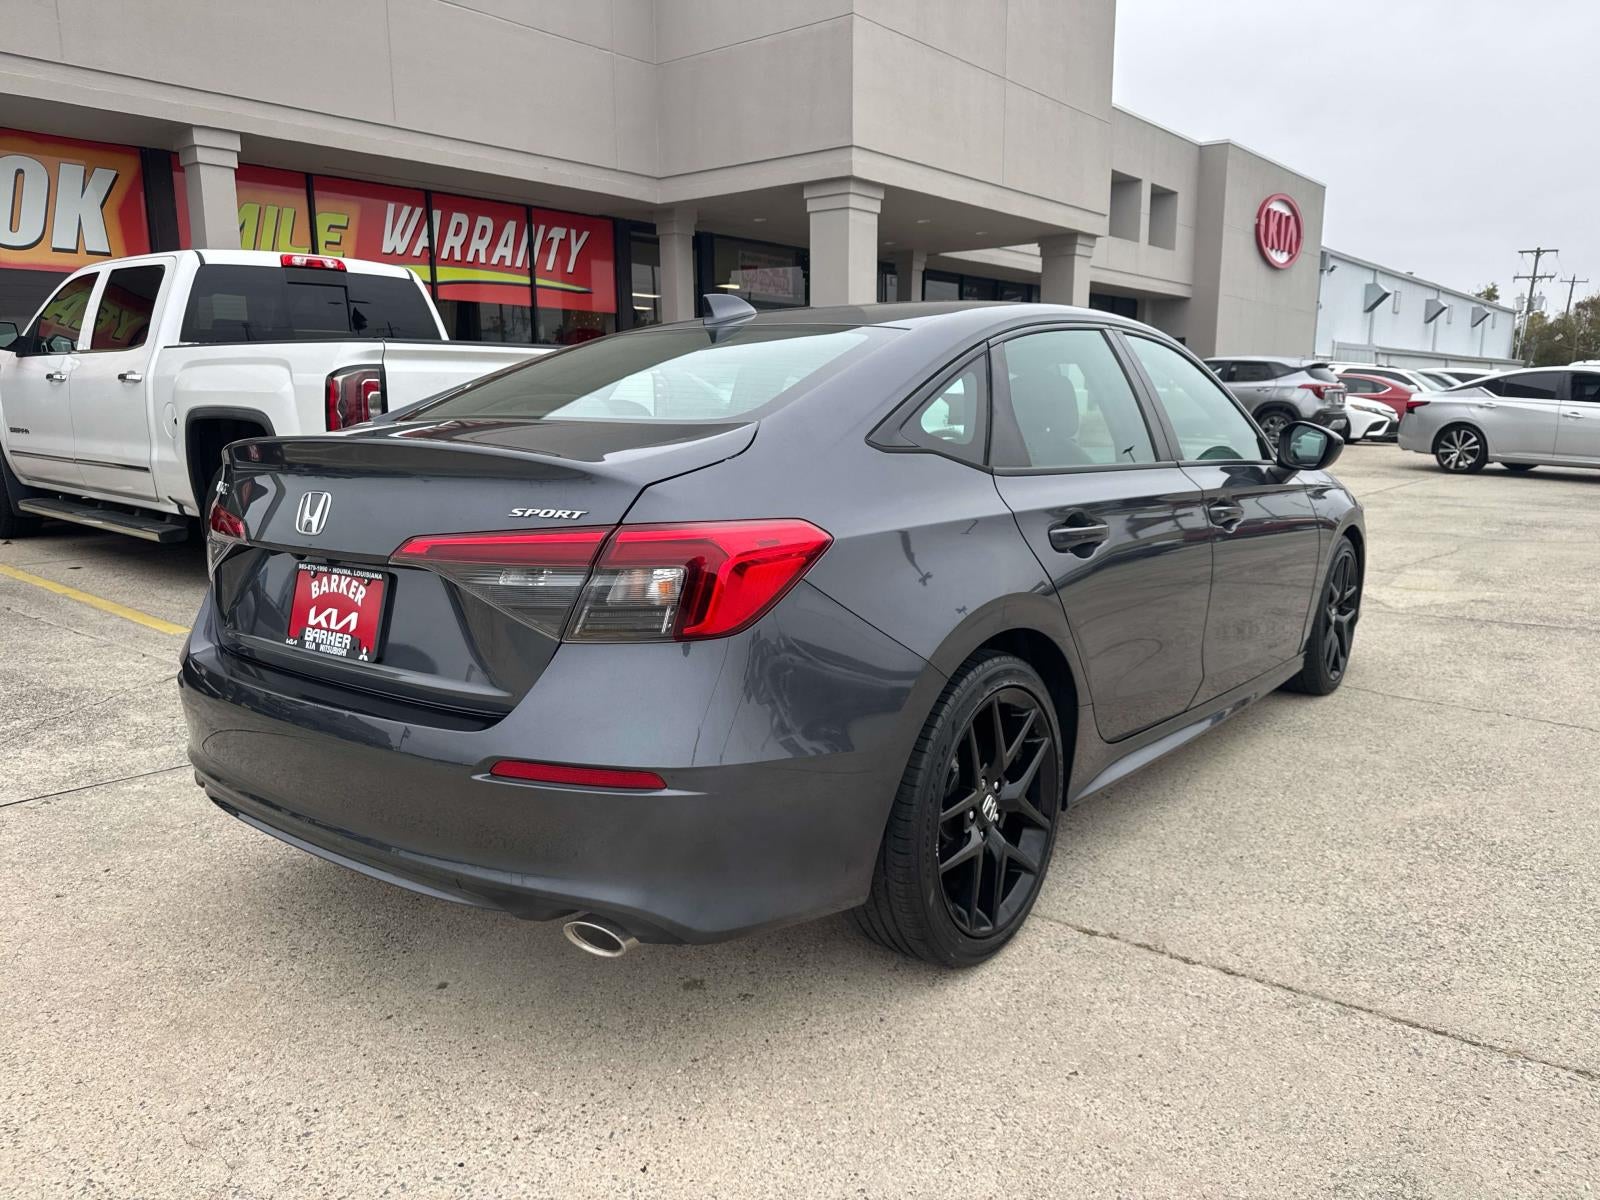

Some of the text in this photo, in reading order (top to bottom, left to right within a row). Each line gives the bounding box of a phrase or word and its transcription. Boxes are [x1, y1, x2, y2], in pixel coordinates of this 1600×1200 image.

[0, 155, 119, 257] OK
[381, 202, 590, 274] WARRANTY
[1264, 207, 1297, 254] KIA
[507, 507, 590, 520] SPORT
[311, 574, 366, 607] BARKER
[304, 627, 352, 649] BARKER
[305, 641, 348, 656] KIA MITSUBISHI
